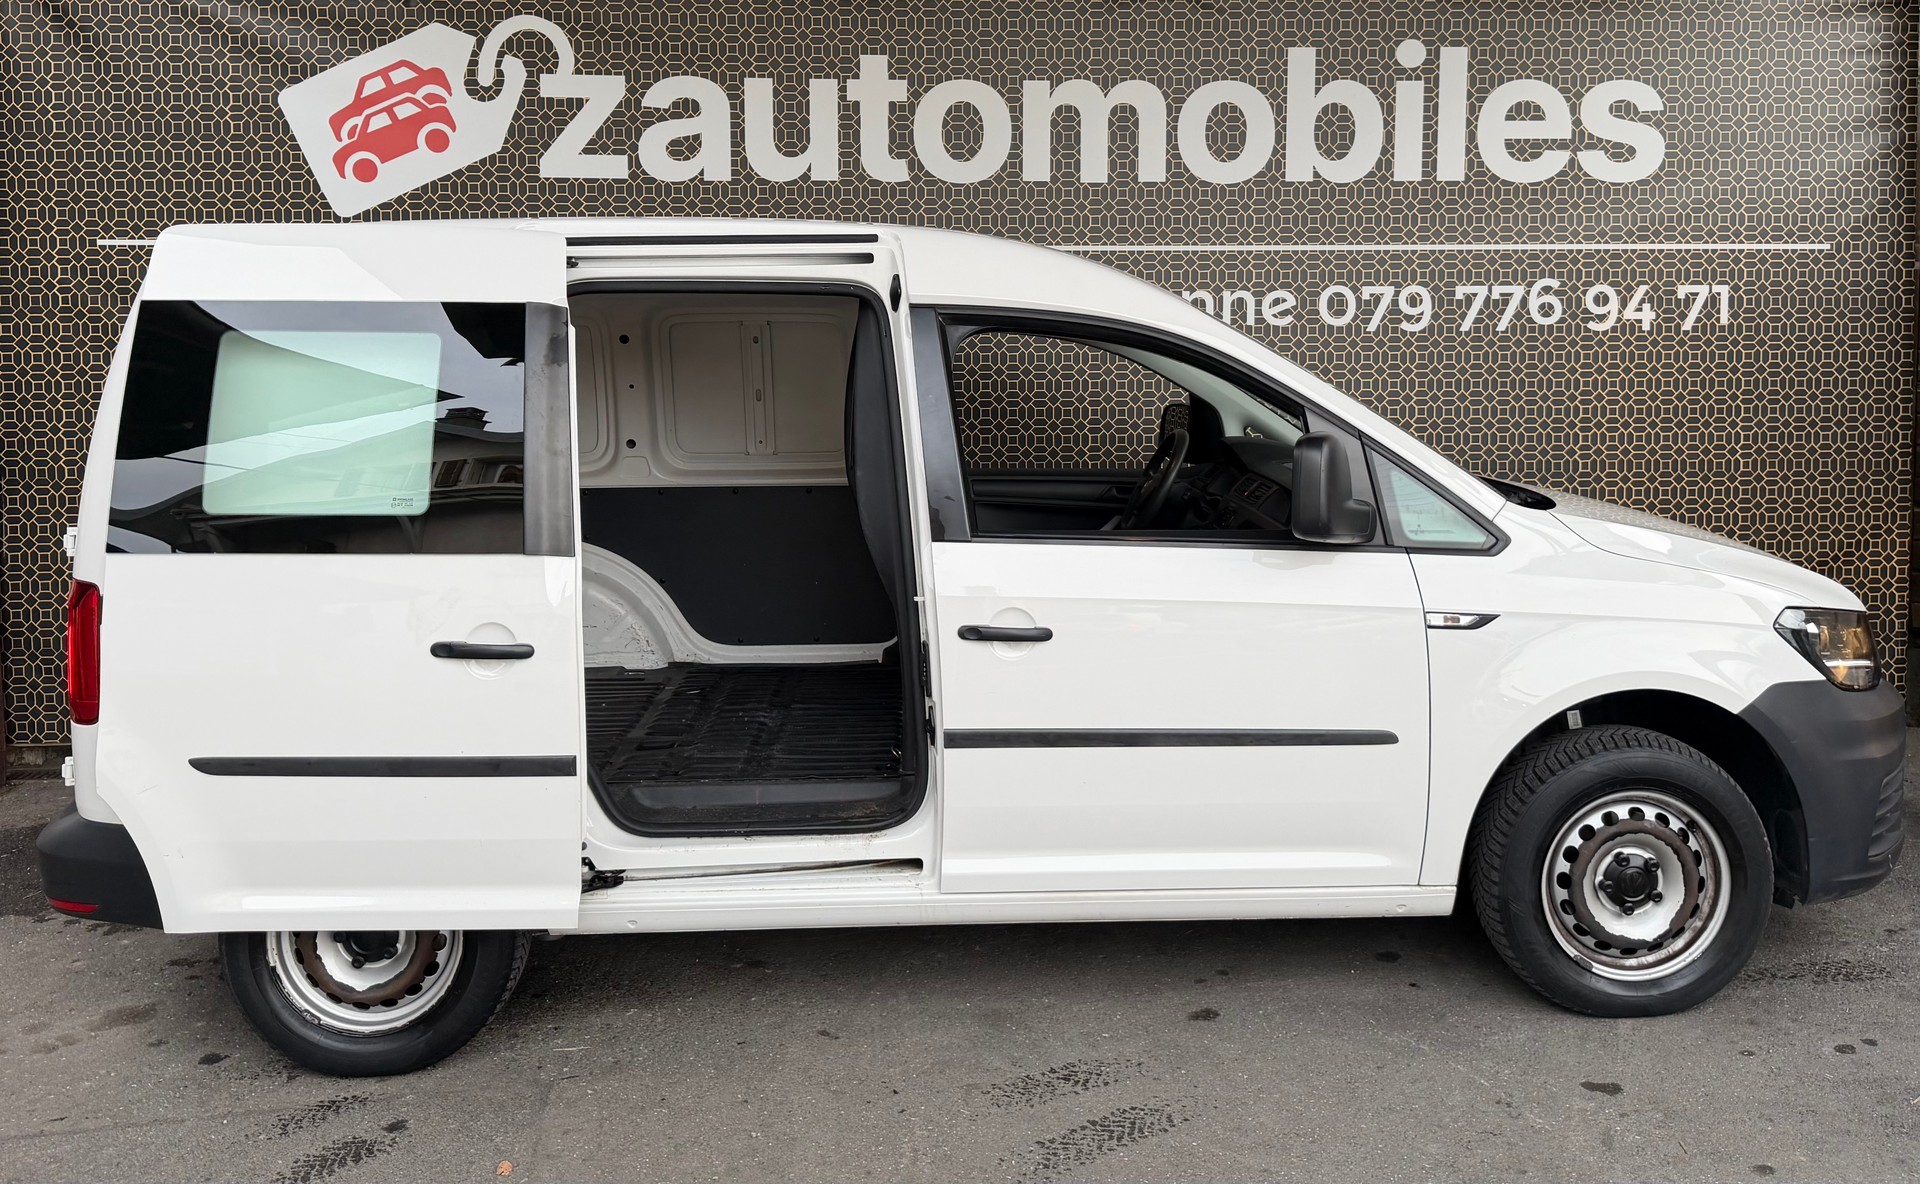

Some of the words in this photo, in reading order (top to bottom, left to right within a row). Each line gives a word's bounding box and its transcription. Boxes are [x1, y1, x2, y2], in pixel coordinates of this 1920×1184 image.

[539, 39, 1665, 184] zautomobiles
[1319, 285, 1432, 332] 079
[1455, 278, 1562, 331] 776
[1585, 284, 1656, 331] 94
[1677, 285, 1729, 331] 71
